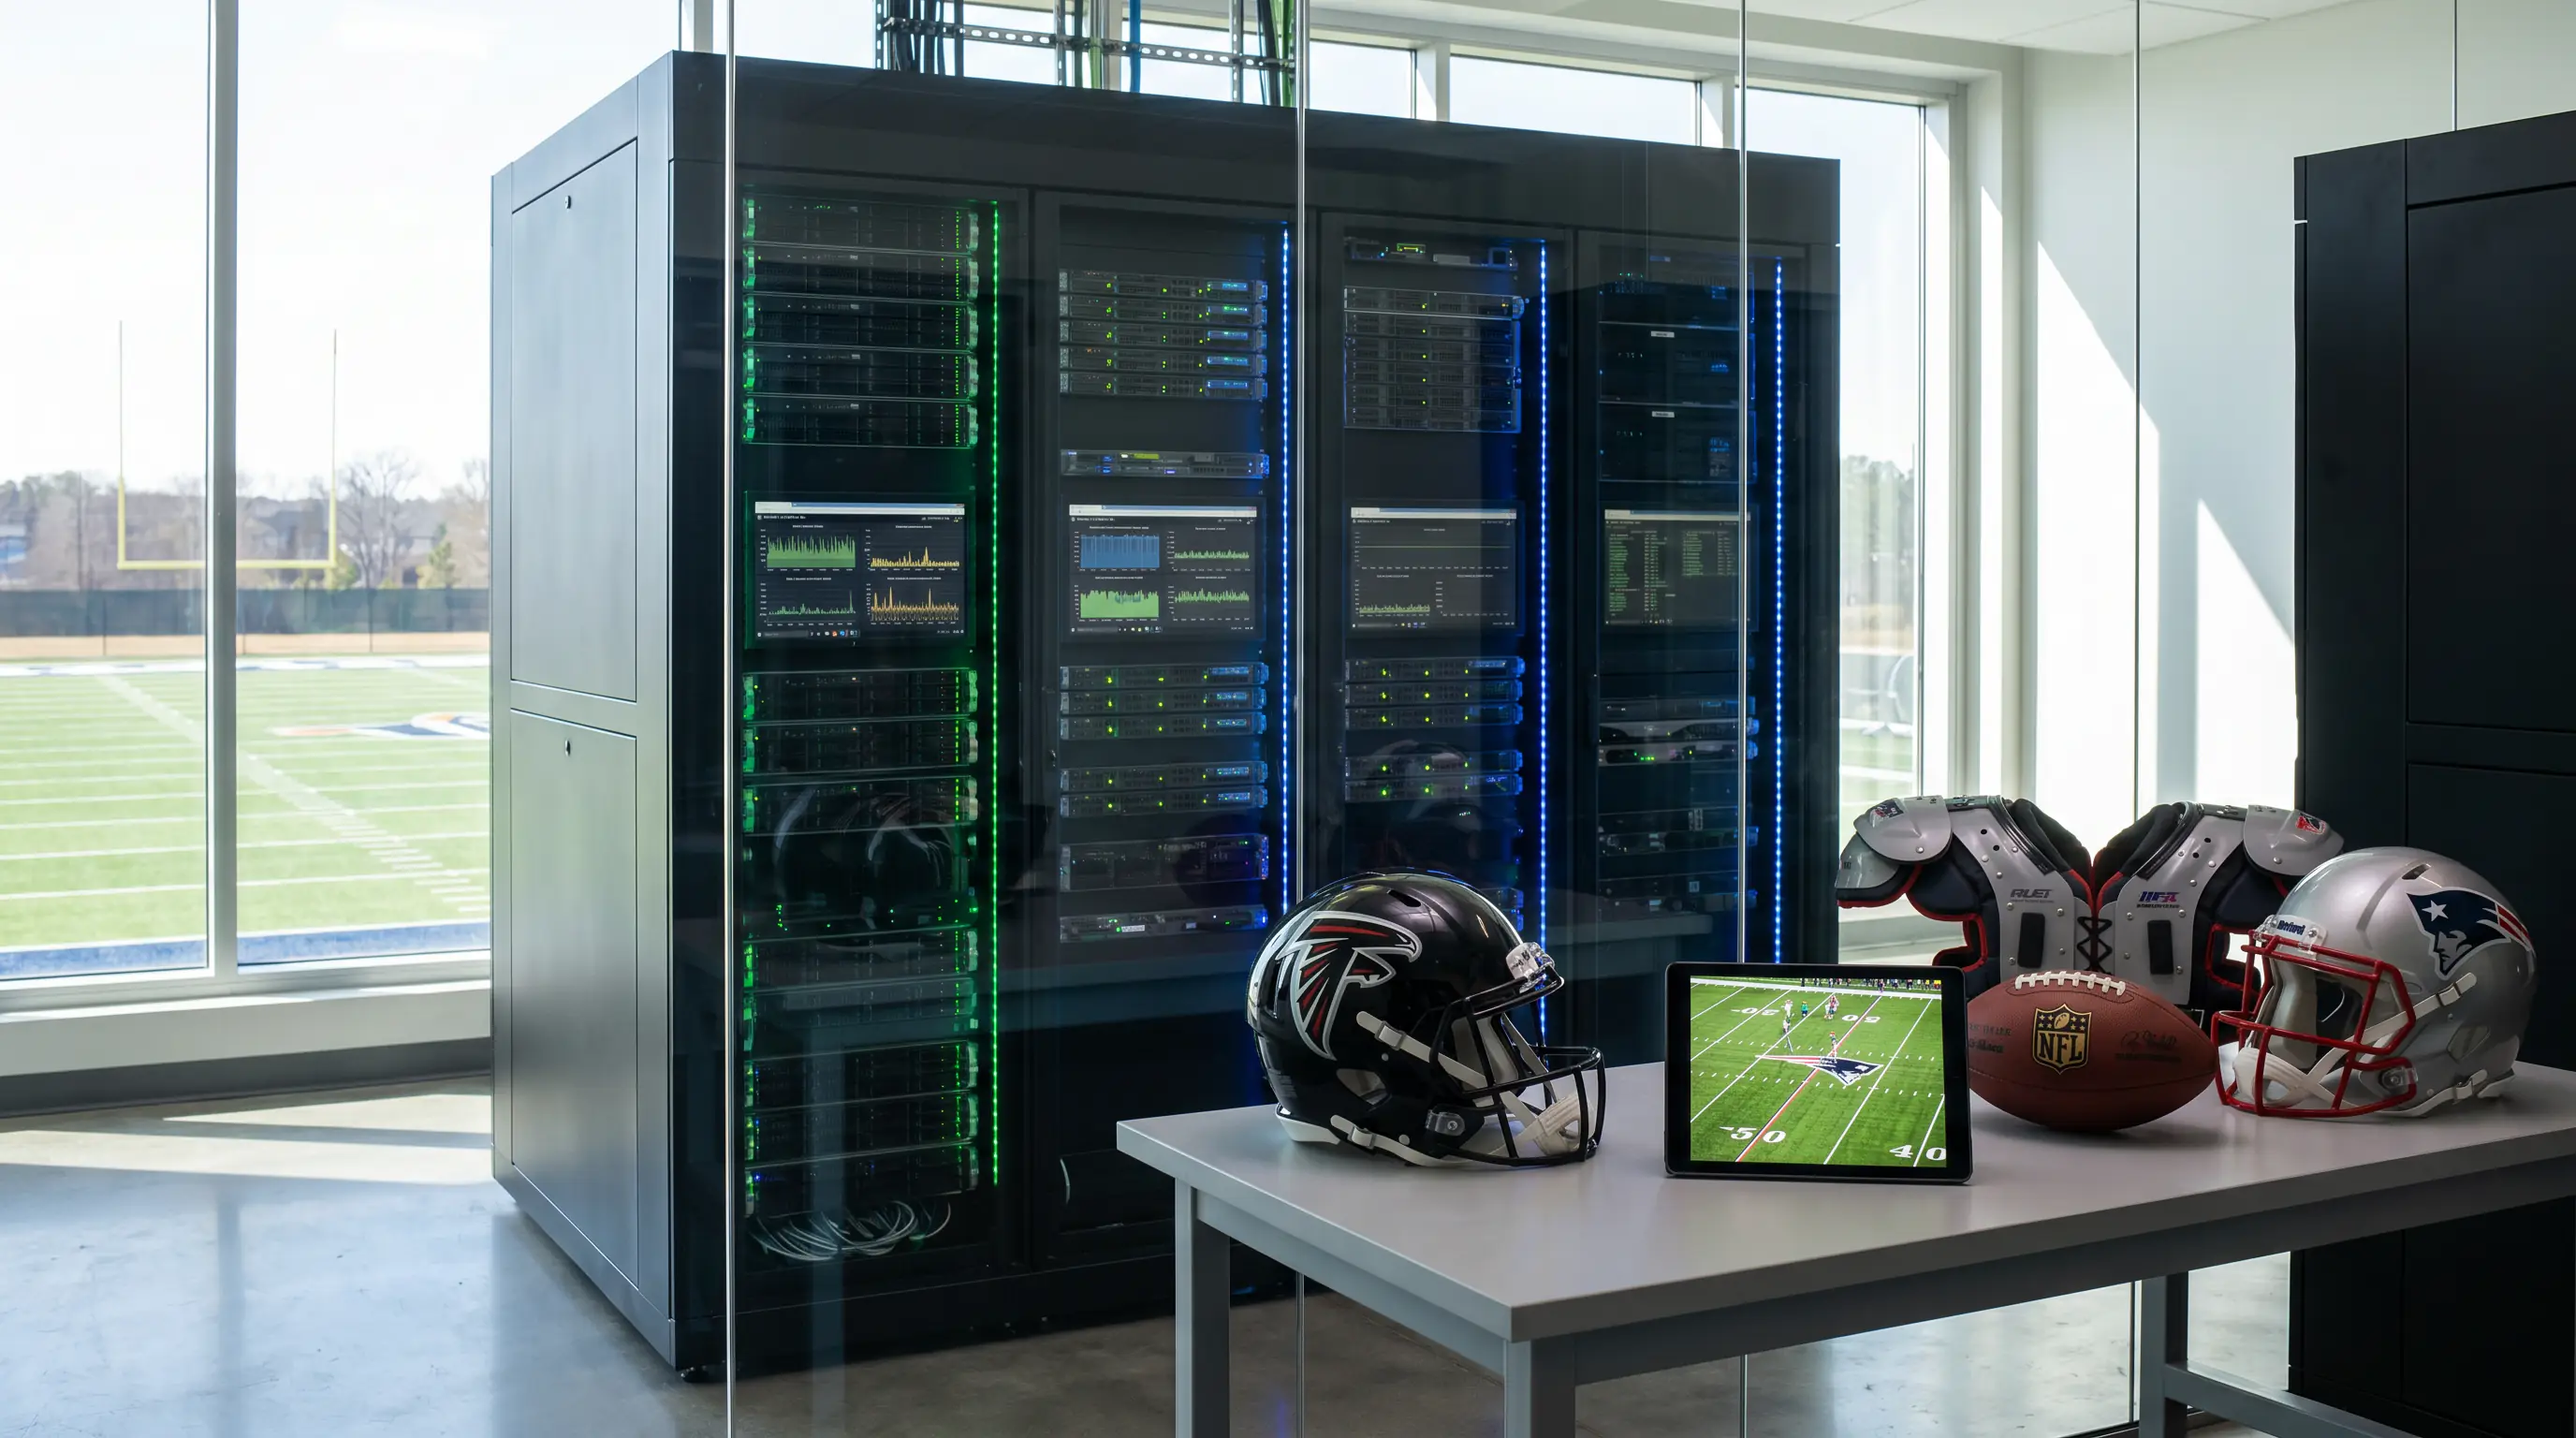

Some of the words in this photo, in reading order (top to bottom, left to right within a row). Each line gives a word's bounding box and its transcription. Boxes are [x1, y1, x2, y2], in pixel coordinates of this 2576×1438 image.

[2039, 1033, 2083, 1064] NFL
[1730, 1126, 1787, 1143] 50
[1889, 1144, 1947, 1161] 40
